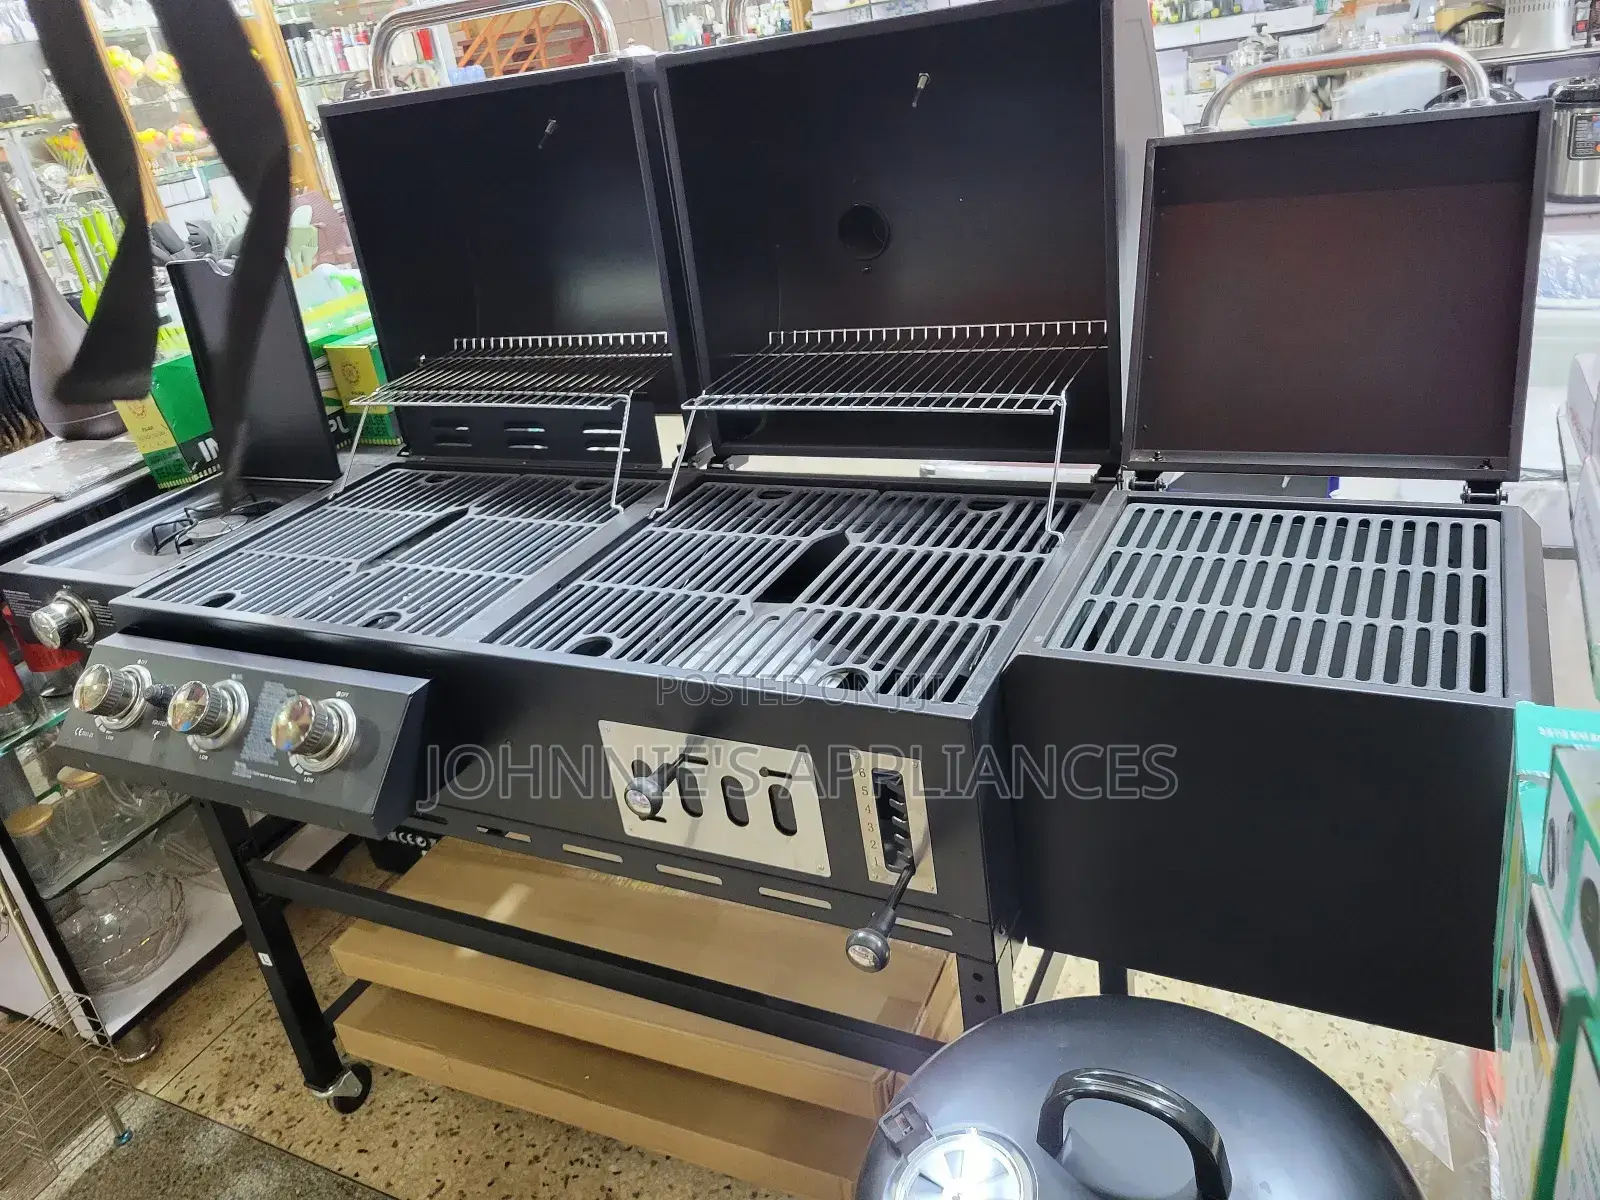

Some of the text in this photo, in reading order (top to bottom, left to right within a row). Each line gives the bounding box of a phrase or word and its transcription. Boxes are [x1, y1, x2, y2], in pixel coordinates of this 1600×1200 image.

[858, 768, 867, 778] 6
[861, 785, 869, 796] 5
[864, 803, 872, 814] 4
[867, 821, 875, 833] 3
[869, 839, 878, 850] 2
